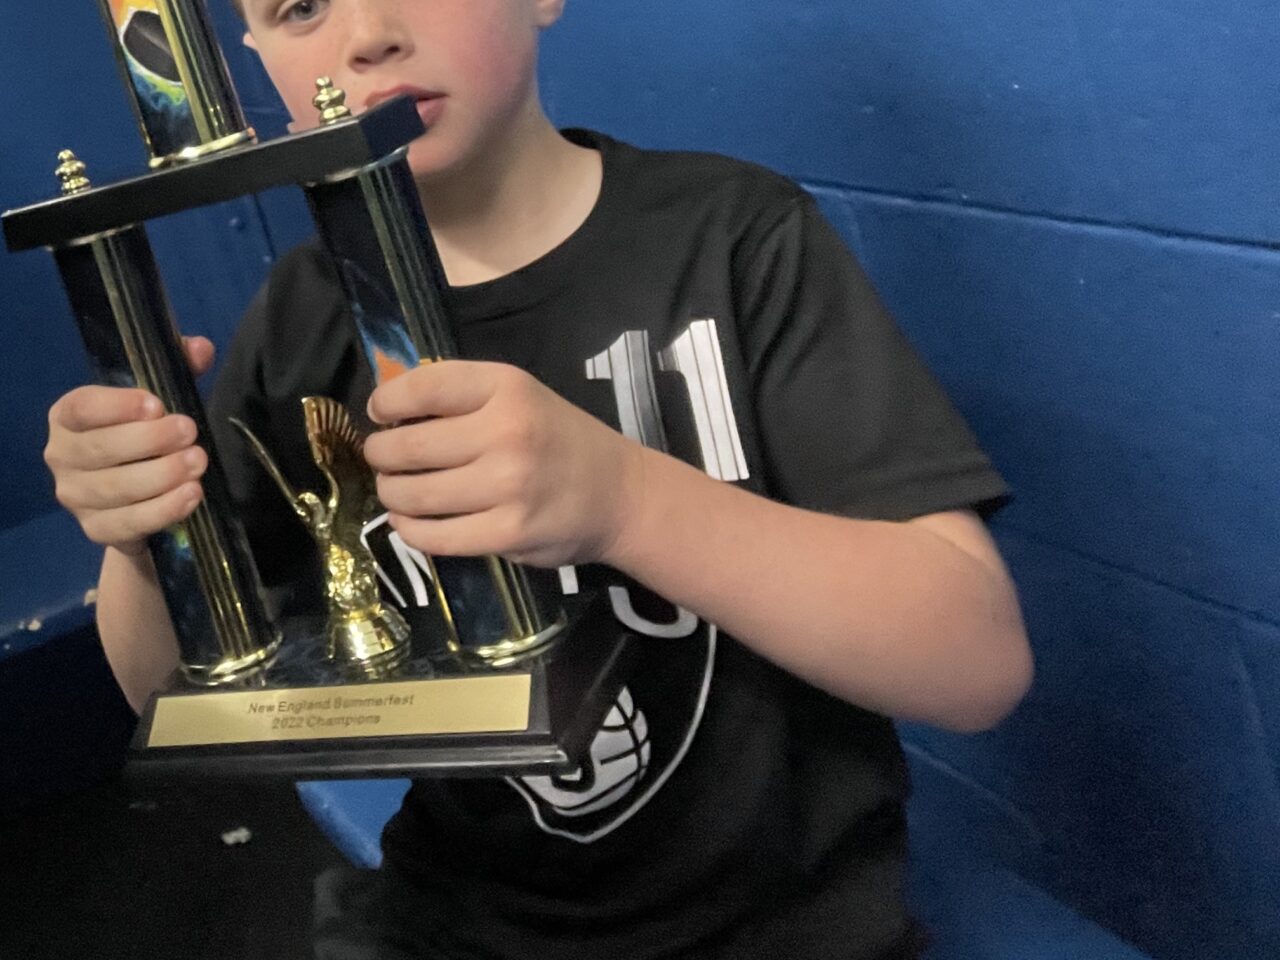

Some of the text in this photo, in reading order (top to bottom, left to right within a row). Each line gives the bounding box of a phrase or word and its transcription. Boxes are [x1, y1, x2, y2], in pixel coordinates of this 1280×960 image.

[585, 318, 749, 481] 11
[248, 694, 415, 714] New England Summerfest
[271, 714, 382, 730] 2022 Champions
